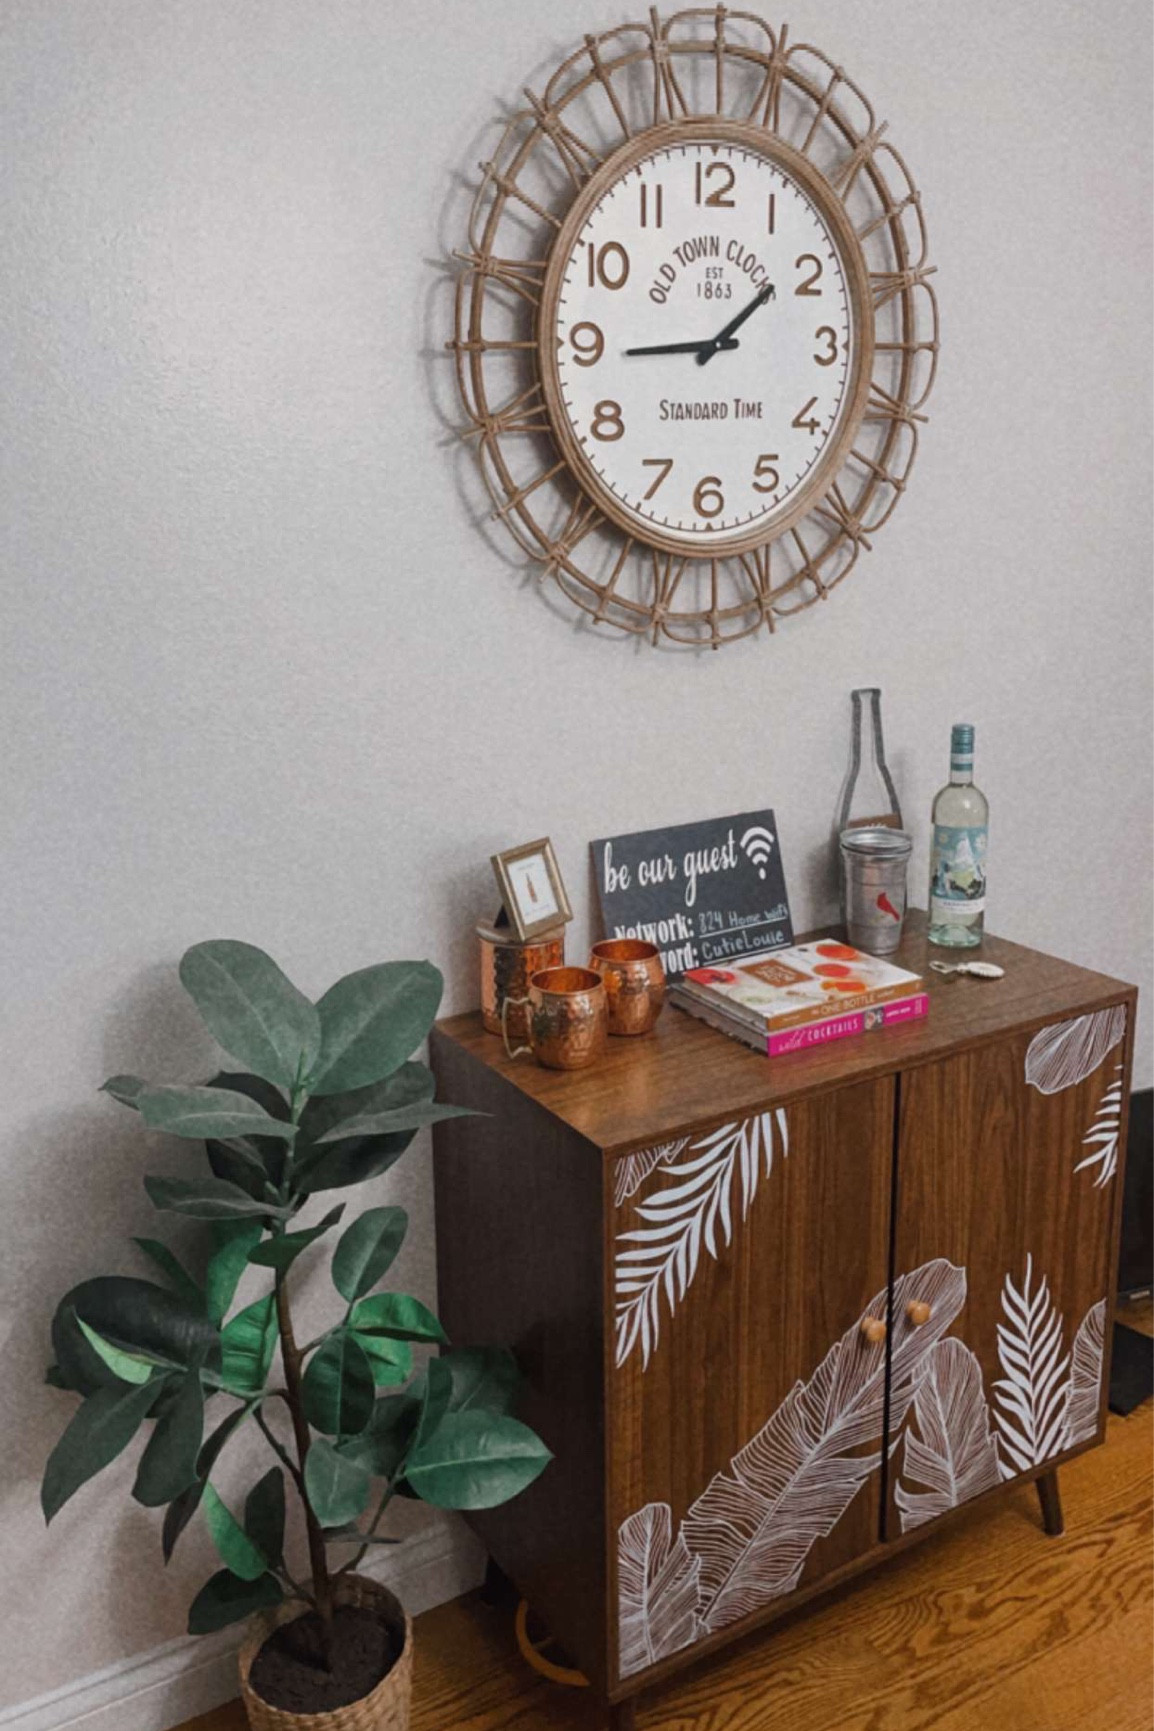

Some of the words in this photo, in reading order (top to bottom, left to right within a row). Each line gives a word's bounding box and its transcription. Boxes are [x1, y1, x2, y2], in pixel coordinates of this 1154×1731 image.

[696, 161, 735, 207] 12
[640, 183, 662, 228] 11
[768, 193, 775, 234] 1
[588, 241, 630, 290] 10
[649, 263, 677, 304] OLD
[672, 235, 720, 267] TOWN
[705, 267, 724, 279] EST
[795, 254, 823, 296] 2
[697, 281, 732, 299] 1863
[570, 322, 605, 367] 9
[813, 326, 837, 366] 3
[590, 400, 625, 442] 8
[792, 397, 821, 435] 4
[642, 459, 673, 500] 7
[752, 454, 779, 493] 5
[693, 476, 724, 518] 6
[604, 842, 631, 893] be
[638, 854, 676, 887] our
[683, 829, 738, 907] guest
[614, 912, 695, 945] Network:
[699, 911, 723, 933] 824
[807, 1018, 859, 1041] COCKTAILS
